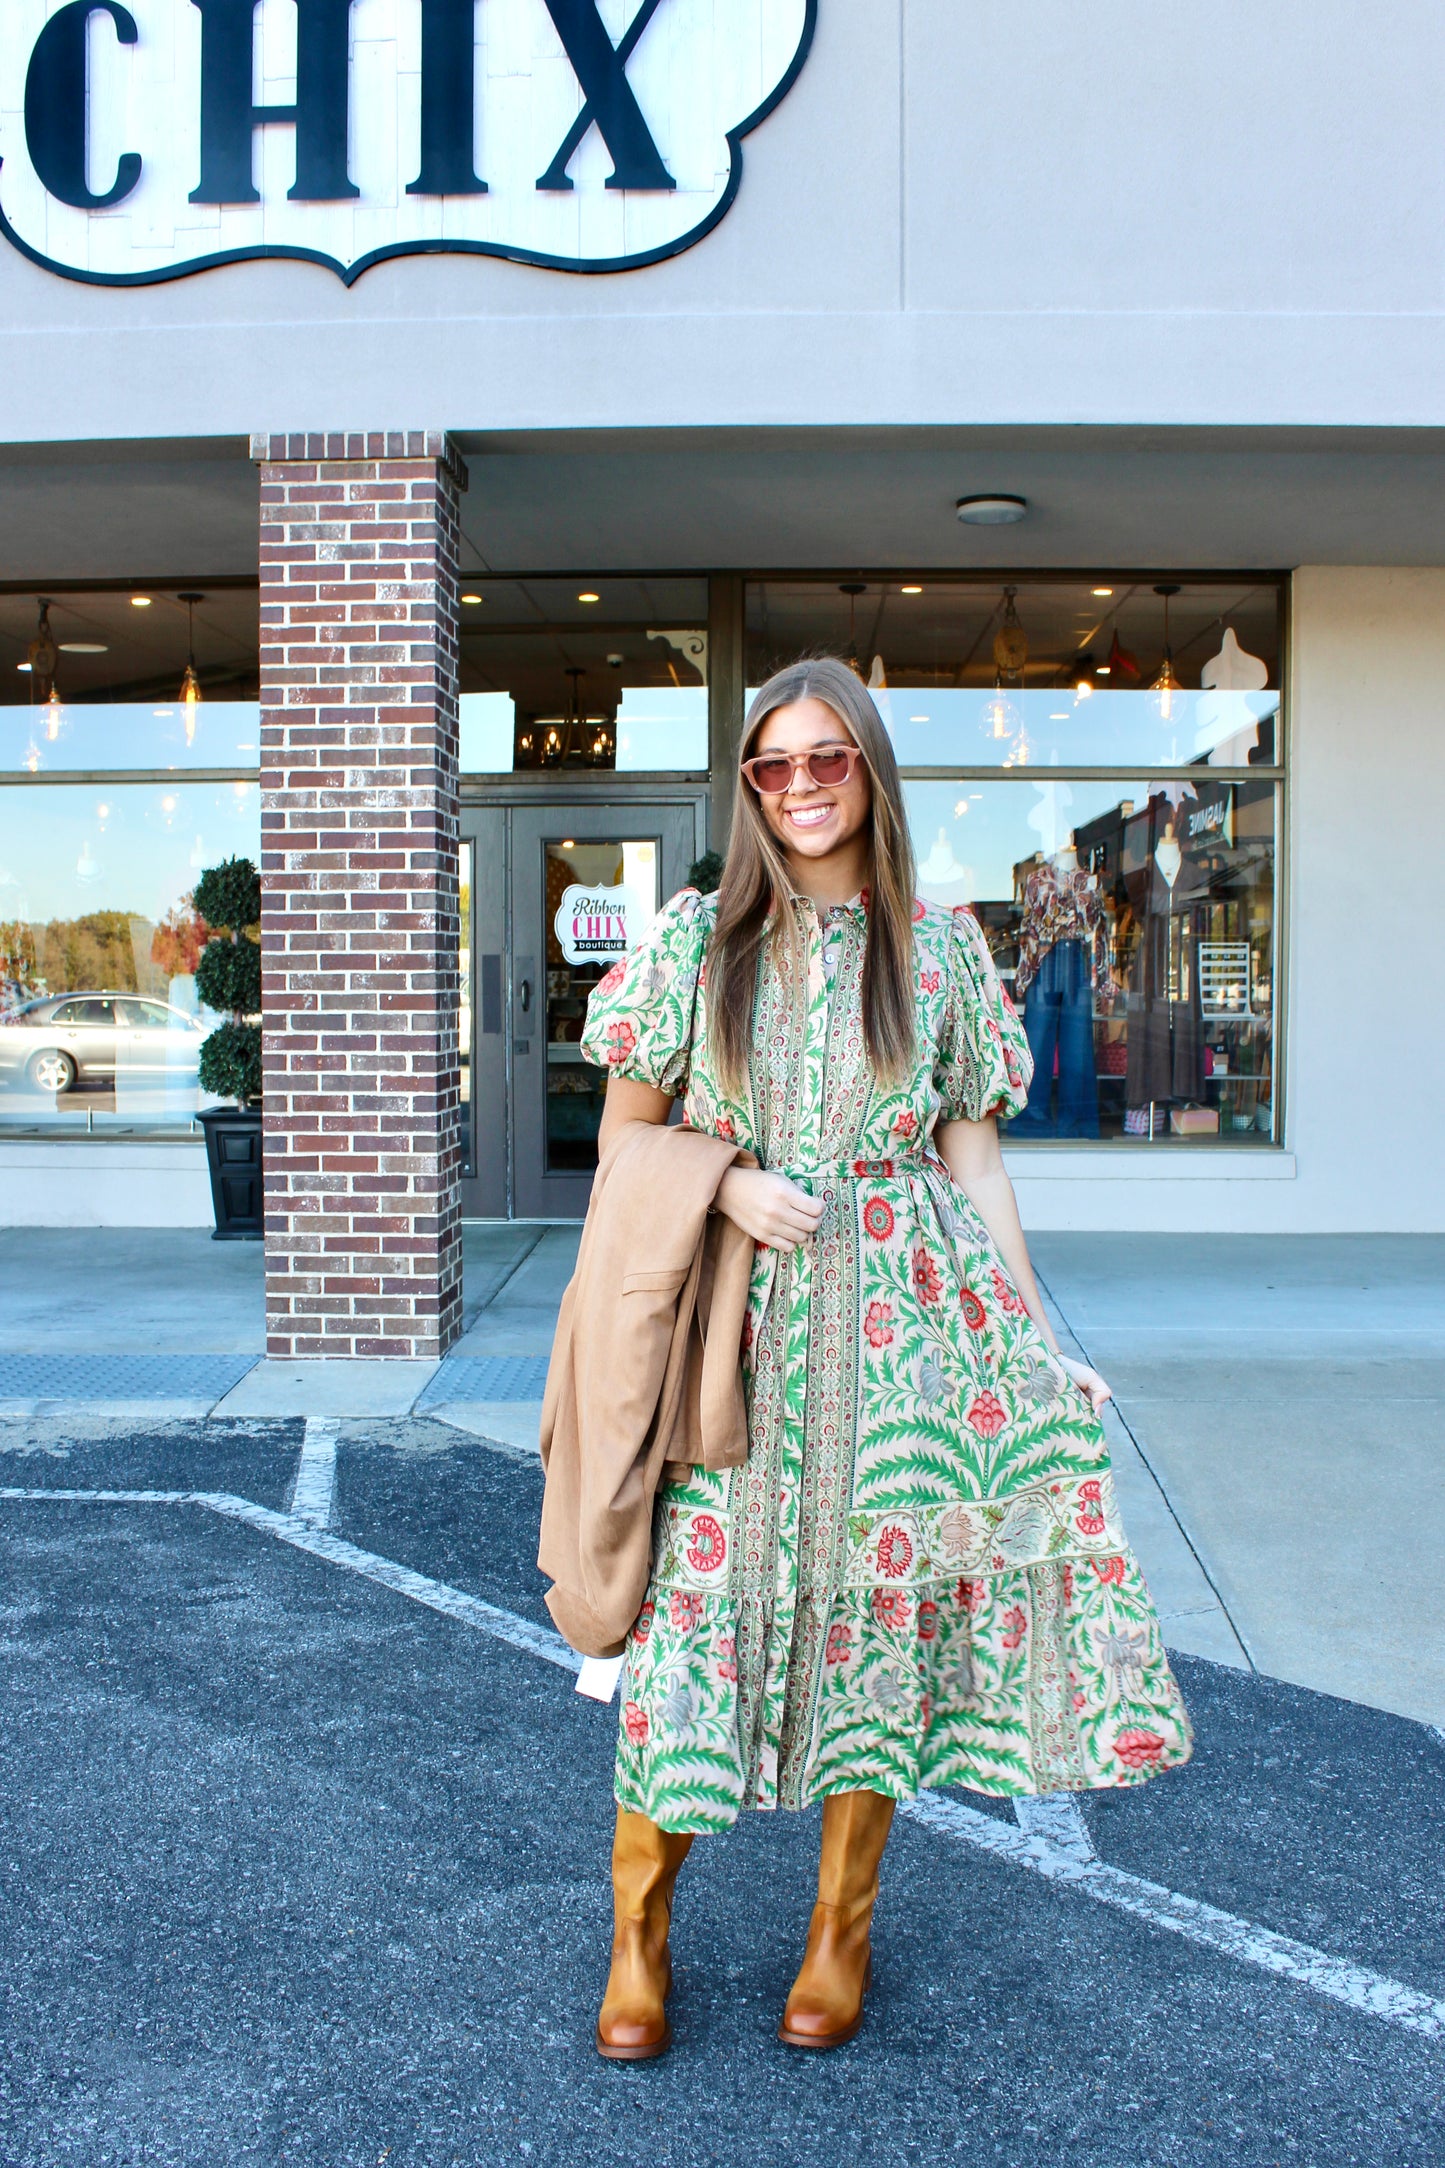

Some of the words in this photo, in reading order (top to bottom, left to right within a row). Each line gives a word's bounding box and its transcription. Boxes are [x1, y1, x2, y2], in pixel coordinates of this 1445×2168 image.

[24, 0, 677, 209] CHIX
[572, 897, 626, 916] Ribbon
[572, 916, 627, 938] CHIX
[579, 941, 623, 950] boutique
